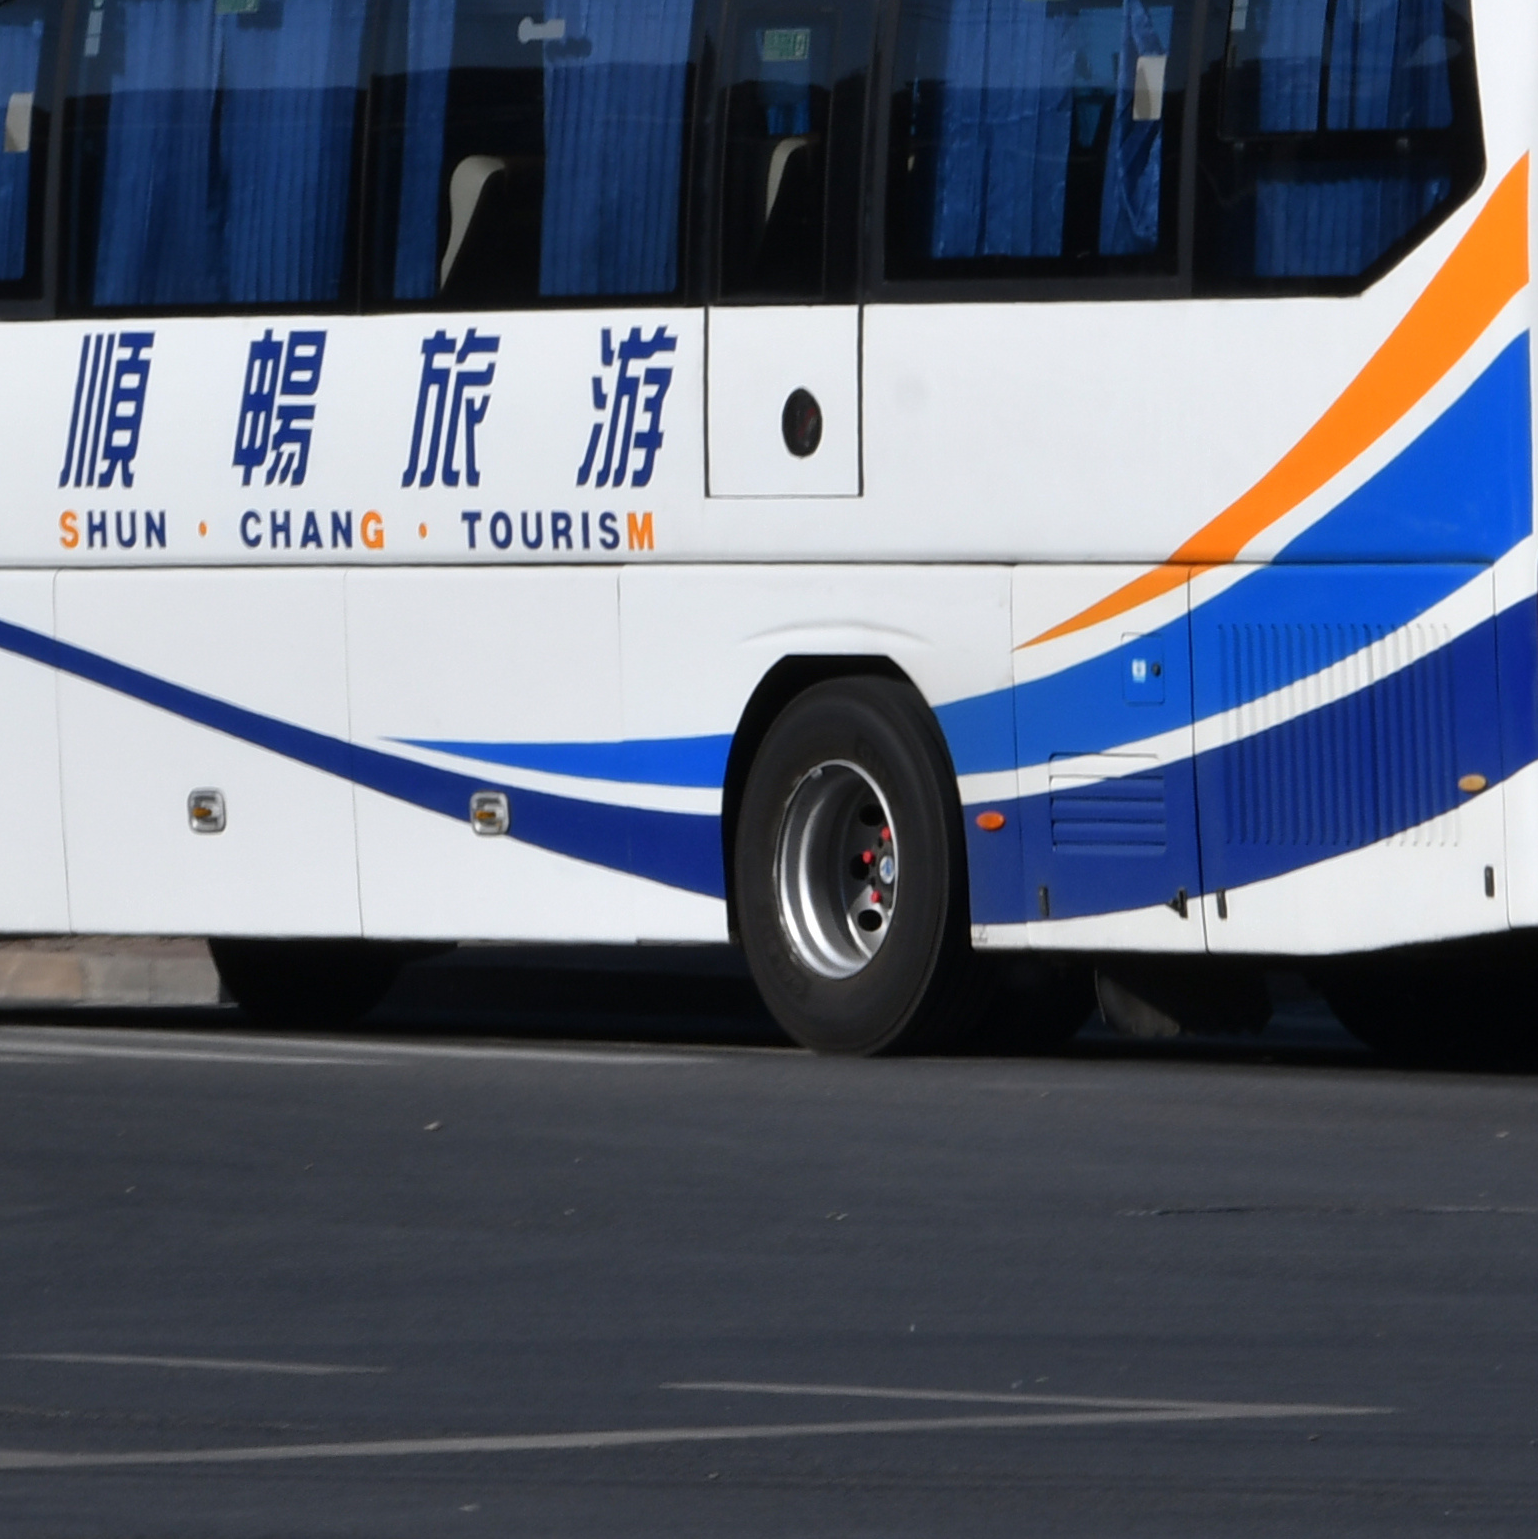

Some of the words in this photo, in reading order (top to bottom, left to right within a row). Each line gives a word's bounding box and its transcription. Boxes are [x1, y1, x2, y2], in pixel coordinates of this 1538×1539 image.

[58, 325, 678, 489] 順暢旅游
[59, 510, 168, 550] SHUN
[239, 510, 385, 550] CHANG
[461, 510, 656, 550] TOURISM
